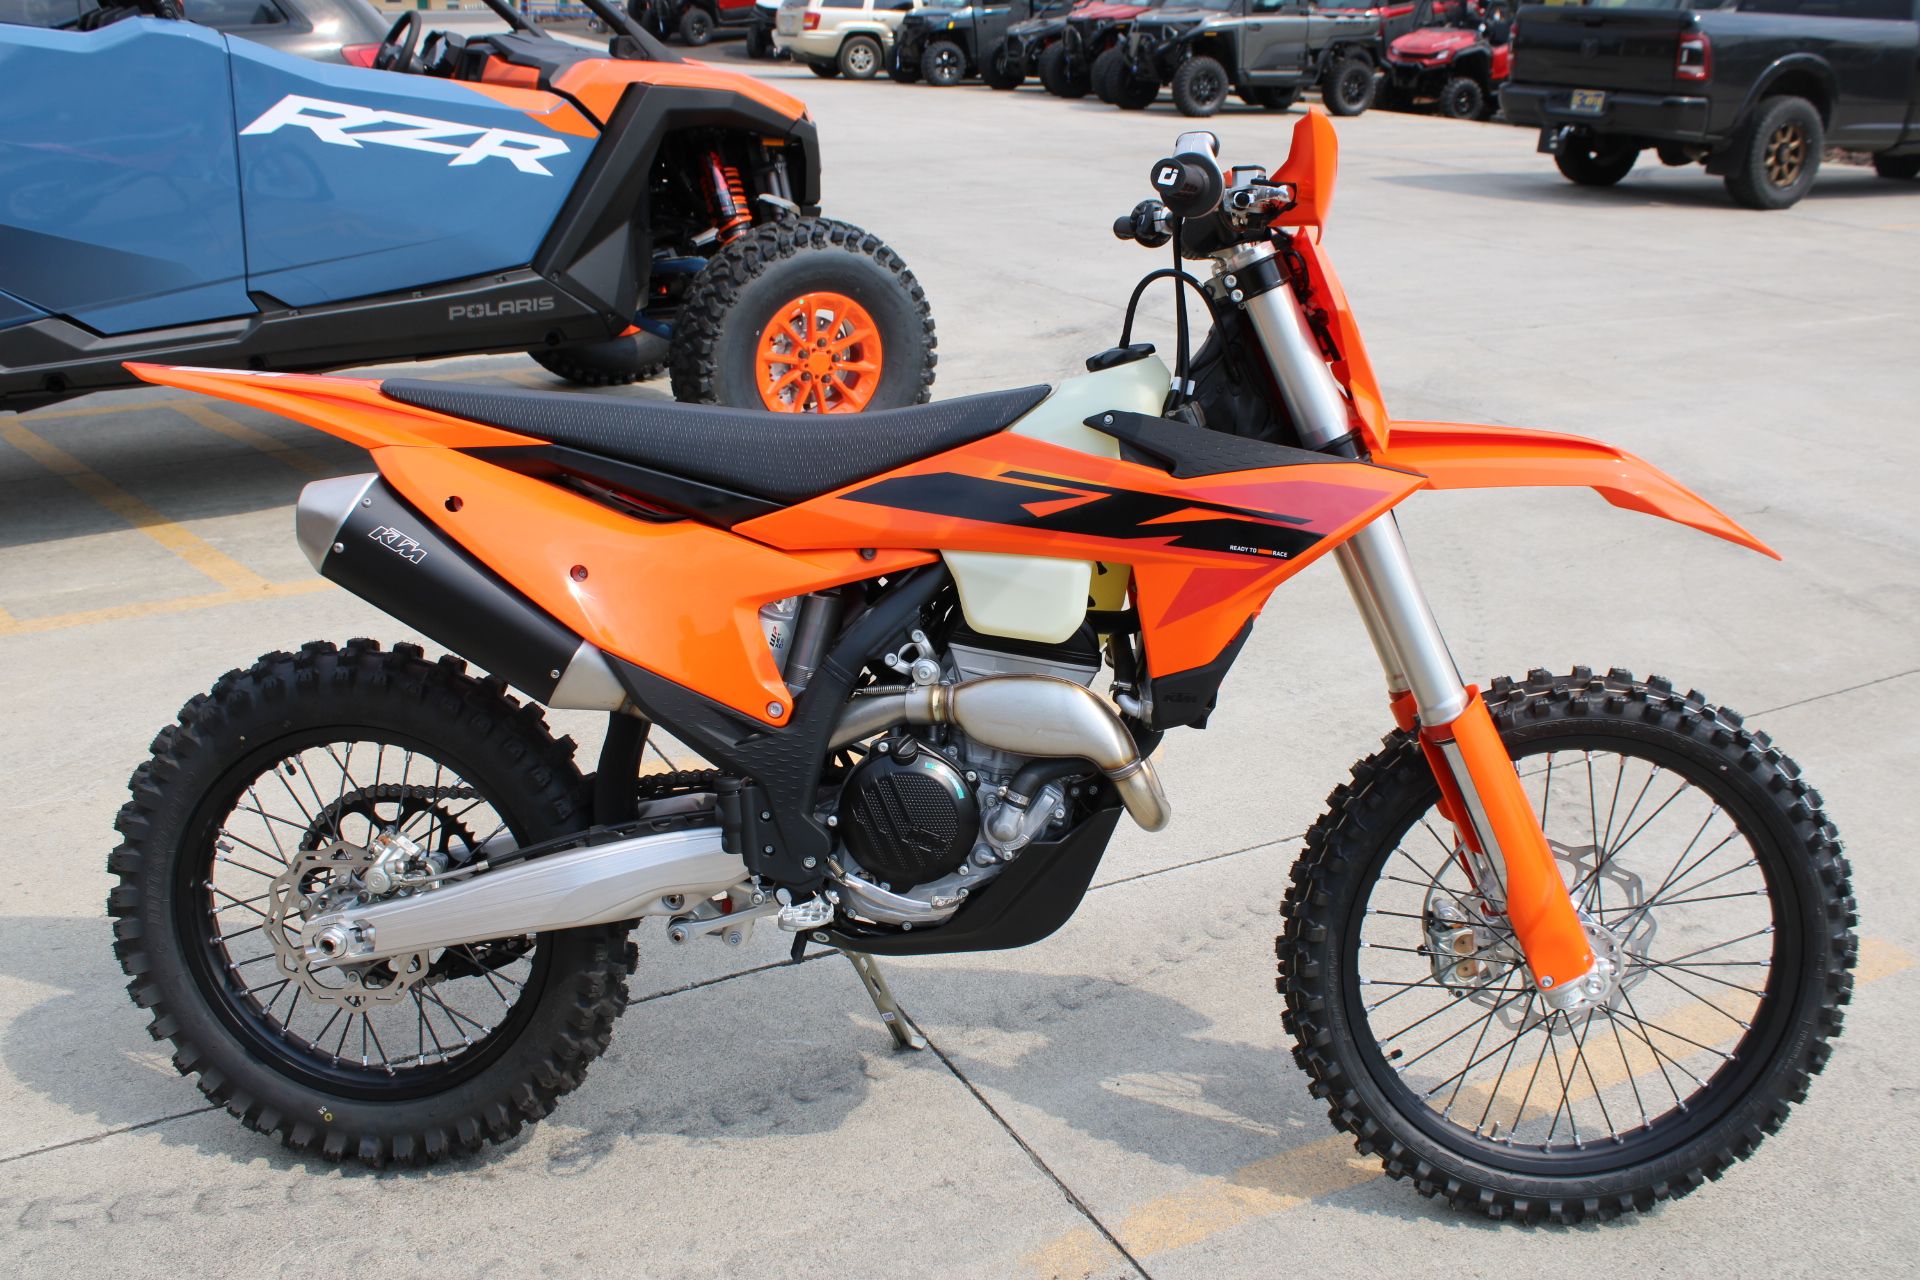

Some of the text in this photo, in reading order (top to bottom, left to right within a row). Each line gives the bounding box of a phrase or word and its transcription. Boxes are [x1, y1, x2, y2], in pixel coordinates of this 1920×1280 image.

[239, 94, 572, 177] RZR
[449, 297, 555, 320] POLARIS
[368, 525, 428, 564] KTM
[1229, 544, 1248, 553] READY
[1272, 550, 1288, 558] RACE
